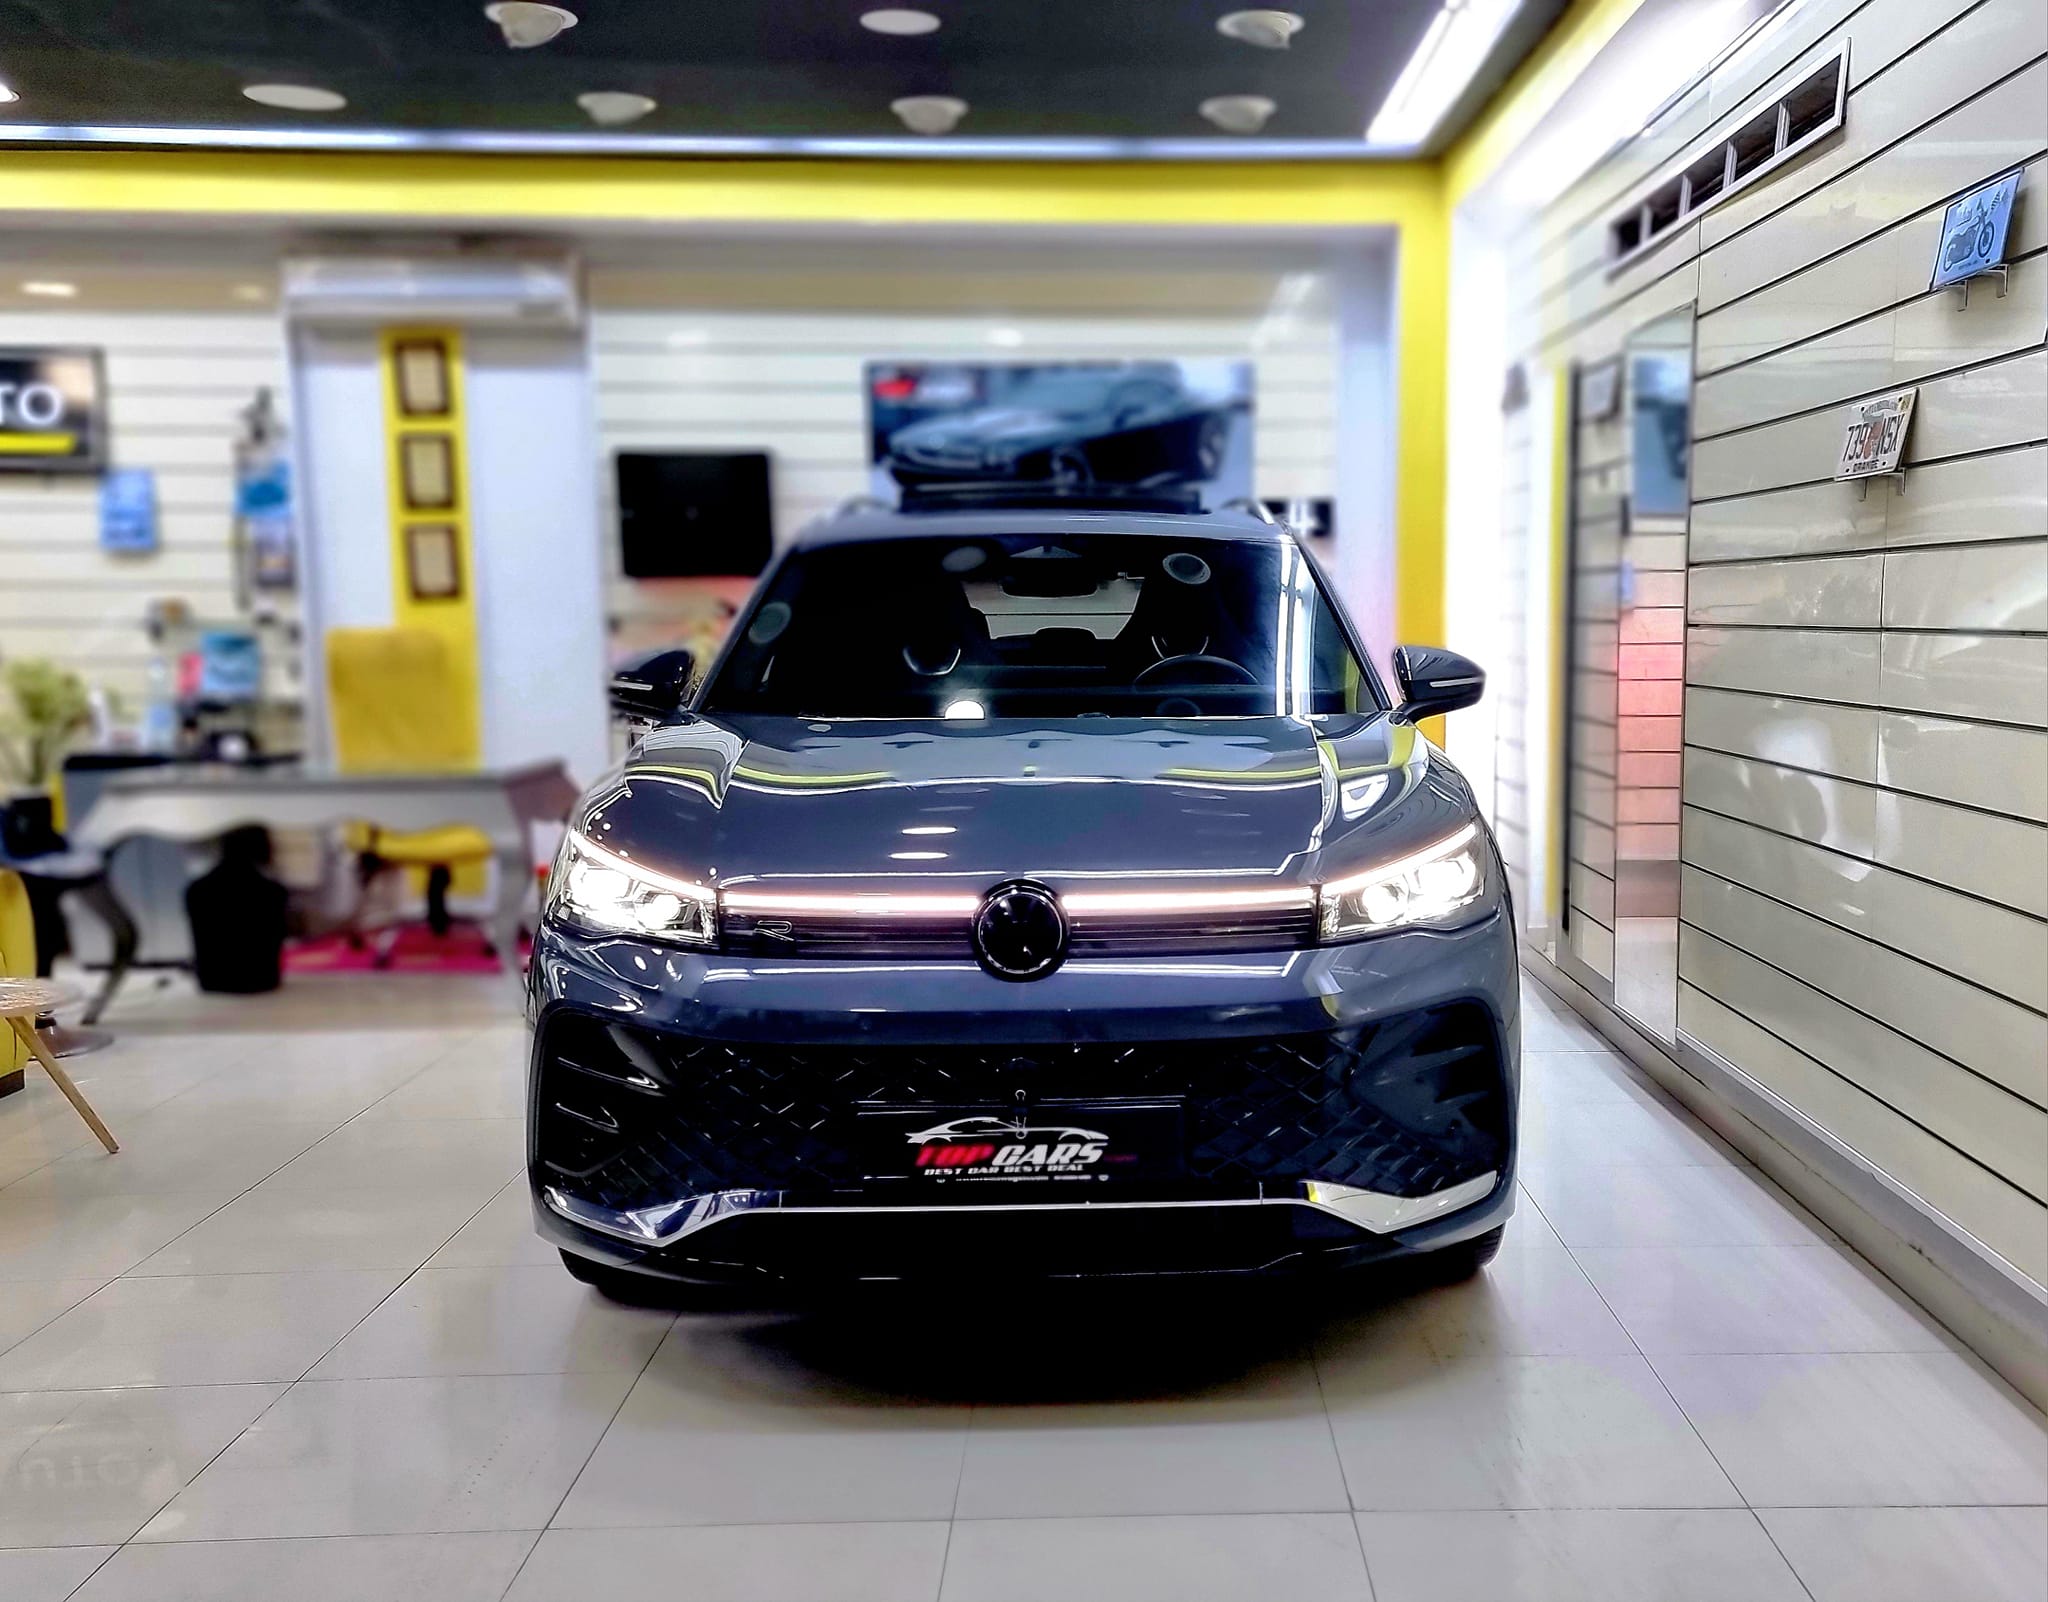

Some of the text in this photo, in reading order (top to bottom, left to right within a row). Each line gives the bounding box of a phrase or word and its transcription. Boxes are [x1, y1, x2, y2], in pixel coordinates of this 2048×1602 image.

[1843, 422, 1872, 461] 739
[914, 1143, 1108, 1168] TOP CARS
[924, 1164, 1083, 1176] BEST CAR BEST DEAL
